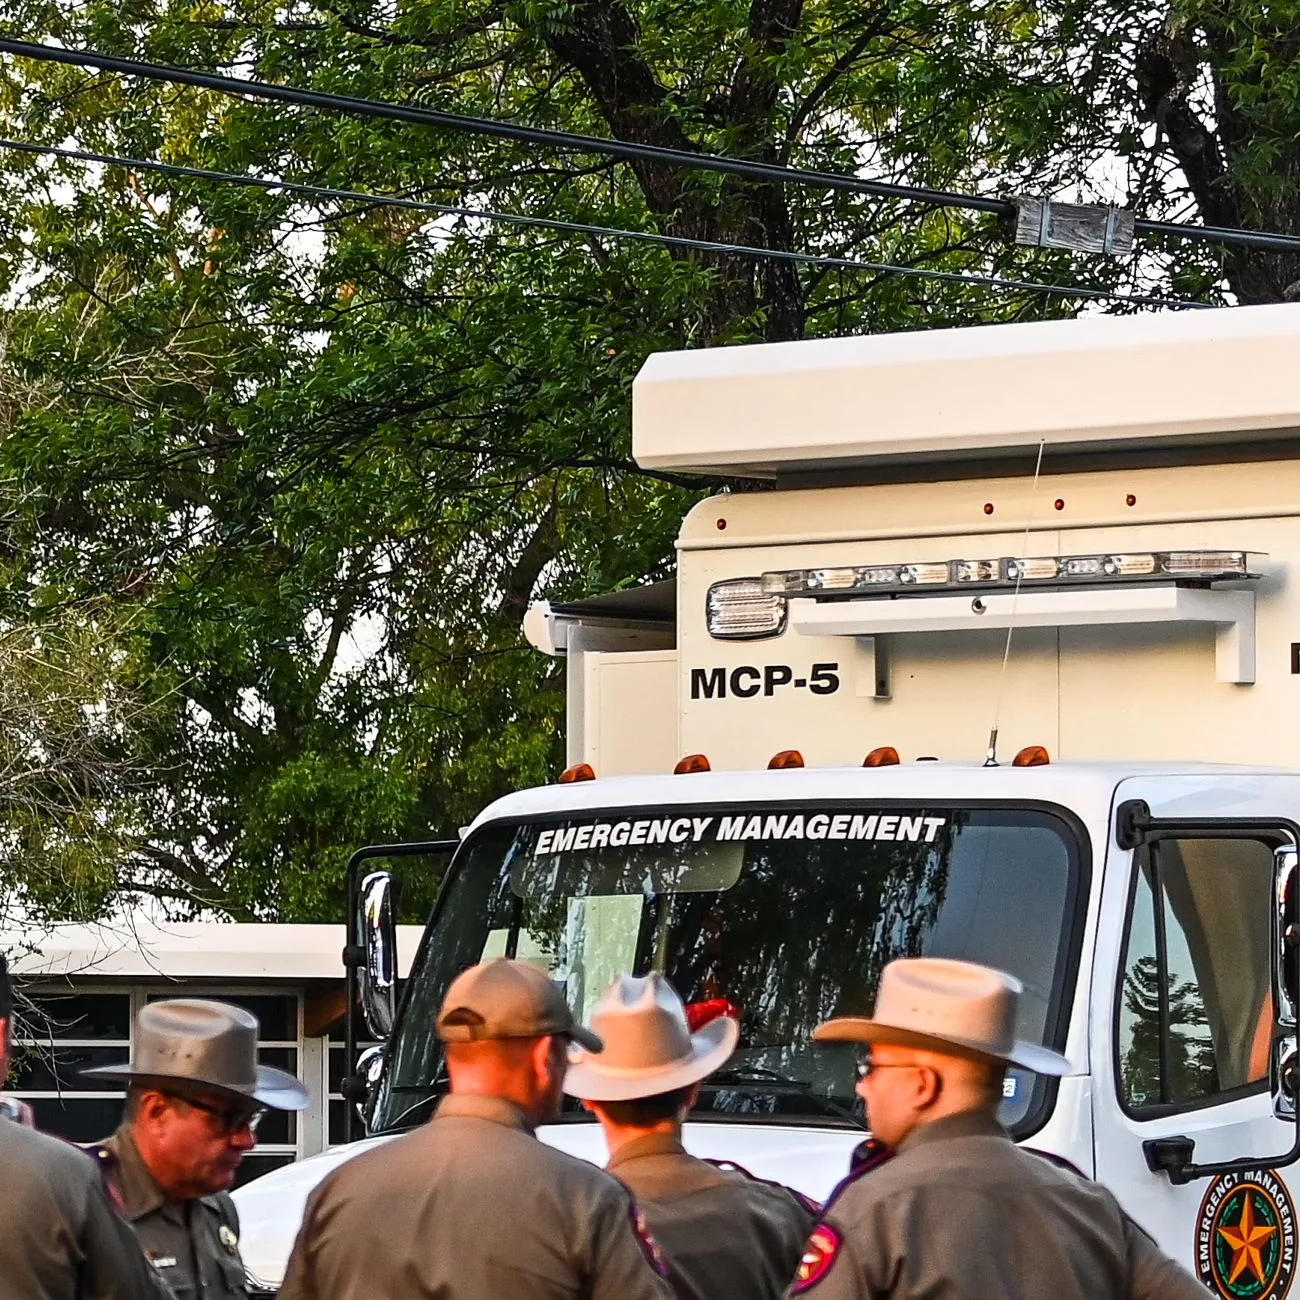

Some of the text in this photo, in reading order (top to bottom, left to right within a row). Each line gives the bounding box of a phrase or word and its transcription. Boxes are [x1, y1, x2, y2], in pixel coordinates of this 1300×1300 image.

[690, 662, 840, 700] MCP-5
[533, 814, 947, 856] EMERGENCY MANAGEMENT
[1200, 1169, 1294, 1275] EMERGENCY MANAGEMENT
